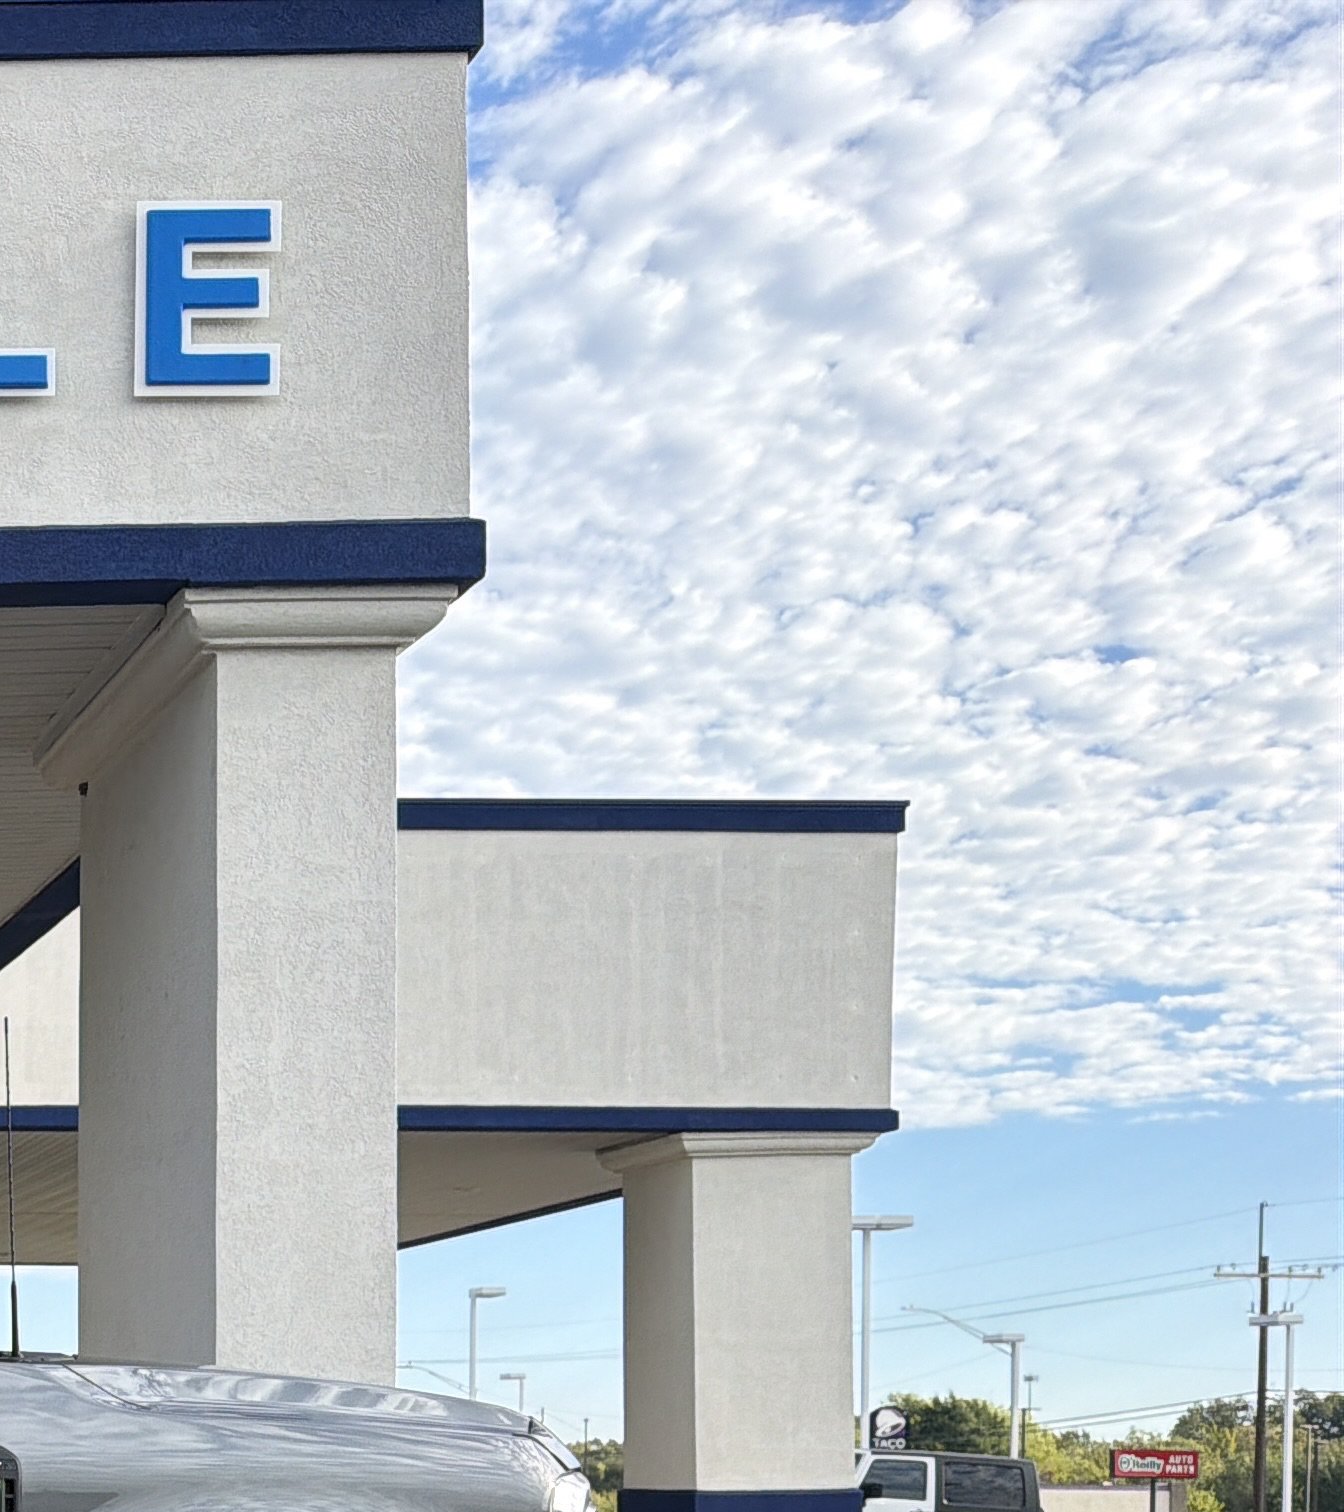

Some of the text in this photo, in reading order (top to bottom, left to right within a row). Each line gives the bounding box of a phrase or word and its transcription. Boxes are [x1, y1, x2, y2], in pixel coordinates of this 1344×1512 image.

[872, 1438, 906, 1449] TACO
[1169, 1455, 1194, 1464] AUTO
[1165, 1464, 1195, 1475] PARTS
